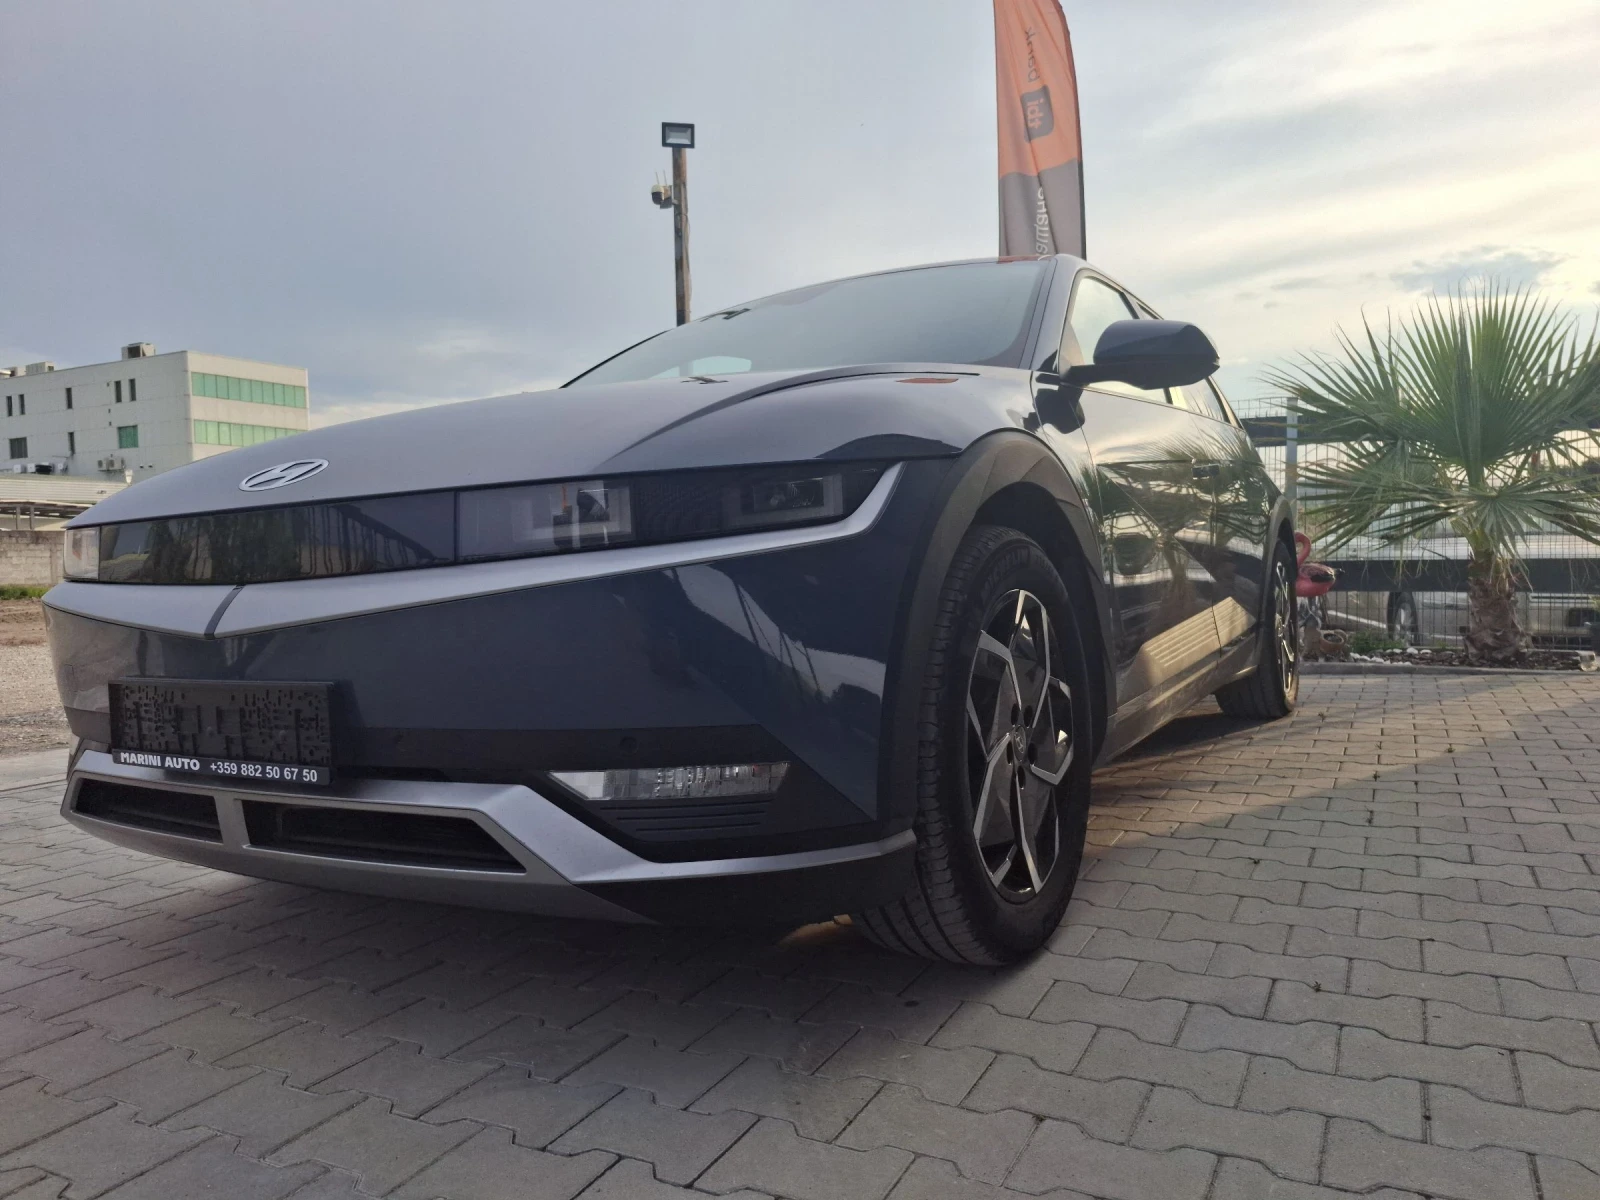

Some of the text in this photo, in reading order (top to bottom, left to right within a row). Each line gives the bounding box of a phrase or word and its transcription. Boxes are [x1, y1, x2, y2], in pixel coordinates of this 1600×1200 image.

[120, 752, 318, 782] MARINI AUTO +359 882 50 67 50
